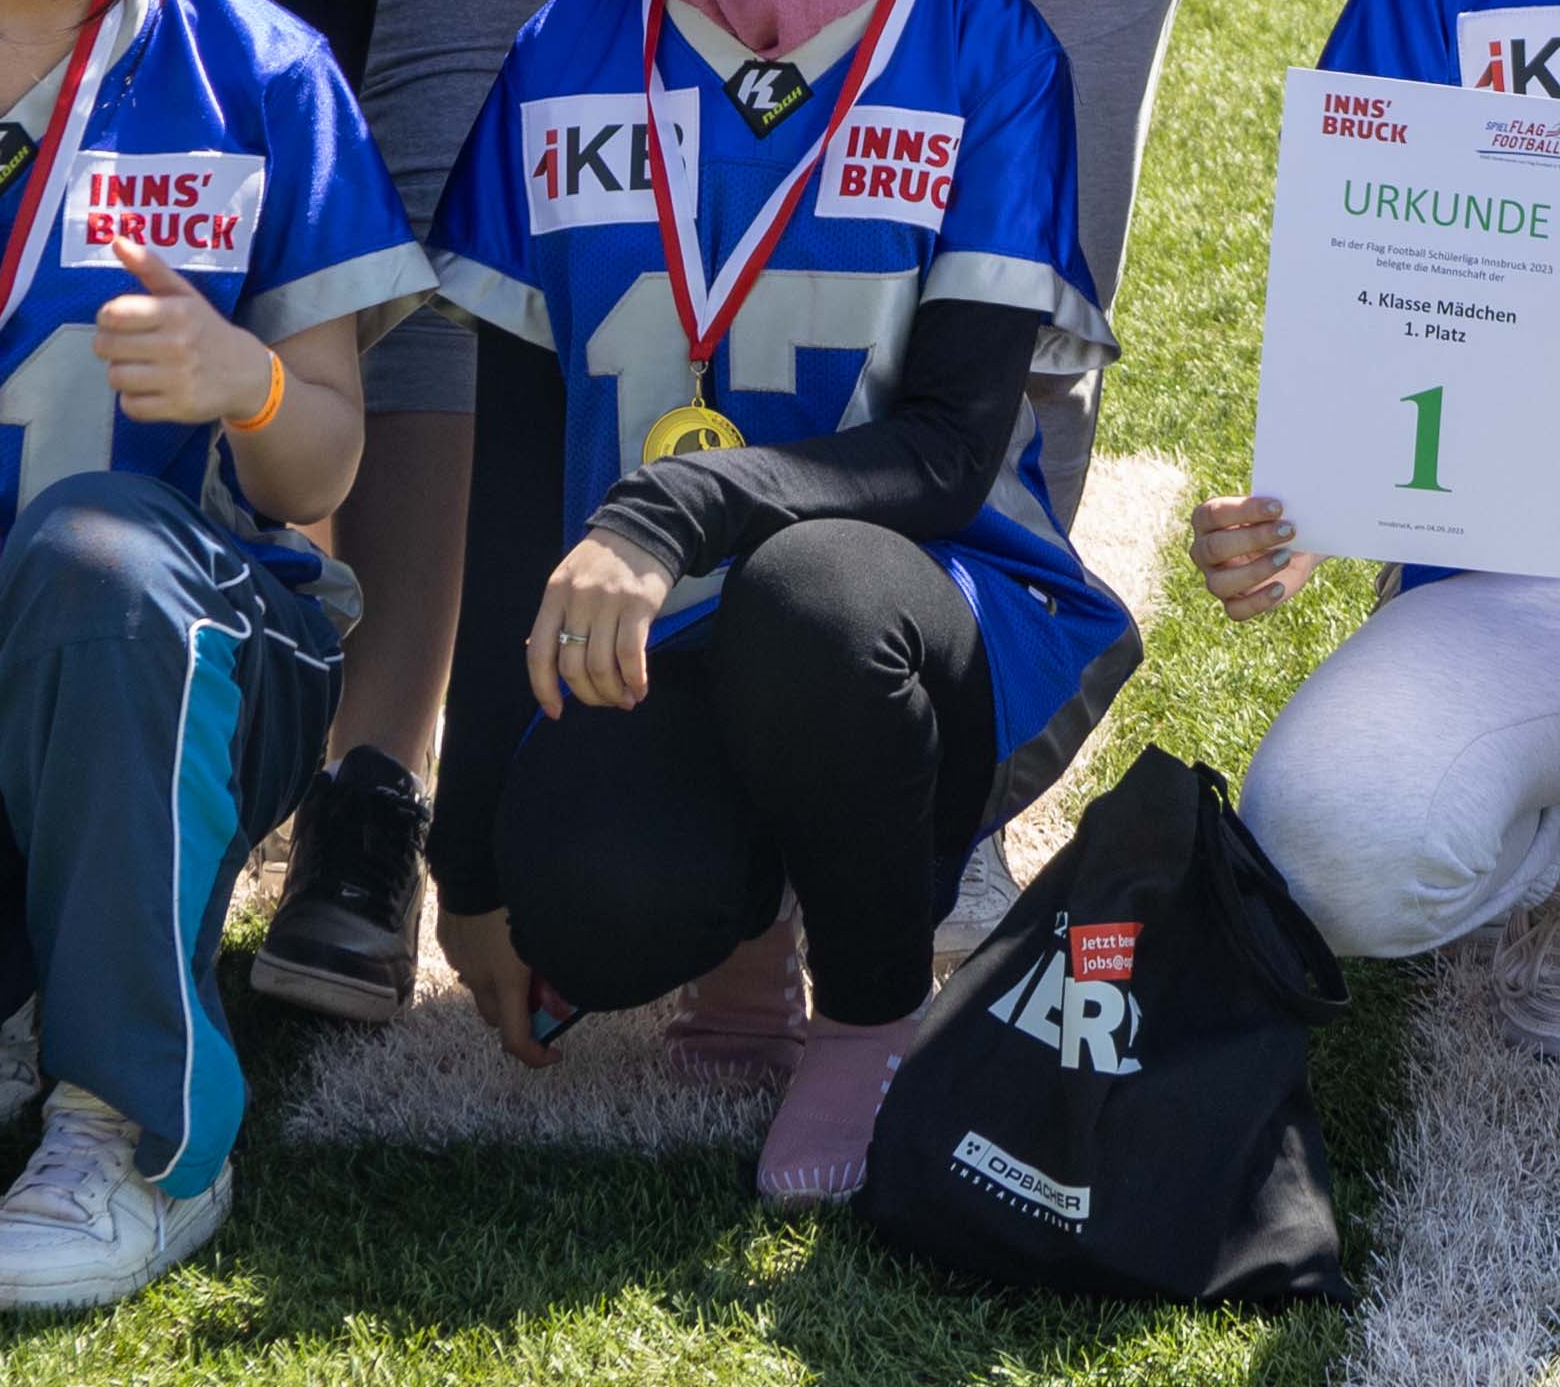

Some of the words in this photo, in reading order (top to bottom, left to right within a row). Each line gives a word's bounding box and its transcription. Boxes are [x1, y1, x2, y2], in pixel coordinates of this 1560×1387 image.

[1323, 92, 1392, 119] INNS'
[1321, 115, 1409, 145] BRUCK
[1491, 133, 1560, 156] FOOTBALL
[1508, 119, 1547, 138] FLAG
[845, 125, 961, 171] INNS'
[88, 171, 214, 209] INNS'
[838, 164, 952, 212] BRUC
[1343, 179, 1552, 241] URKUNDE
[85, 210, 240, 252] BRUCK
[1330, 237, 1347, 249] Bei
[1348, 239, 1365, 251] der
[1366, 241, 1386, 255] Flag
[1387, 244, 1427, 259] Football
[1428, 249, 1480, 267] Schülerliga
[1481, 256, 1528, 273] Innsbruck
[1529, 261, 1555, 276] 2023
[1375, 258, 1413, 273] belegte
[1413, 261, 1429, 274] die
[1430, 263, 1488, 282] Mannschaft
[1488, 271, 1506, 284] der
[1357, 289, 1374, 307] 4.
[1378, 291, 1432, 314] Klasse
[1436, 299, 1518, 325] Mädchen
[1403, 320, 1420, 338] 1.
[1423, 323, 1467, 344] Platz
[1394, 384, 1454, 495] 1
[1081, 934, 1116, 952] Jetzt
[987, 1155, 1082, 1212] OPBACHER
